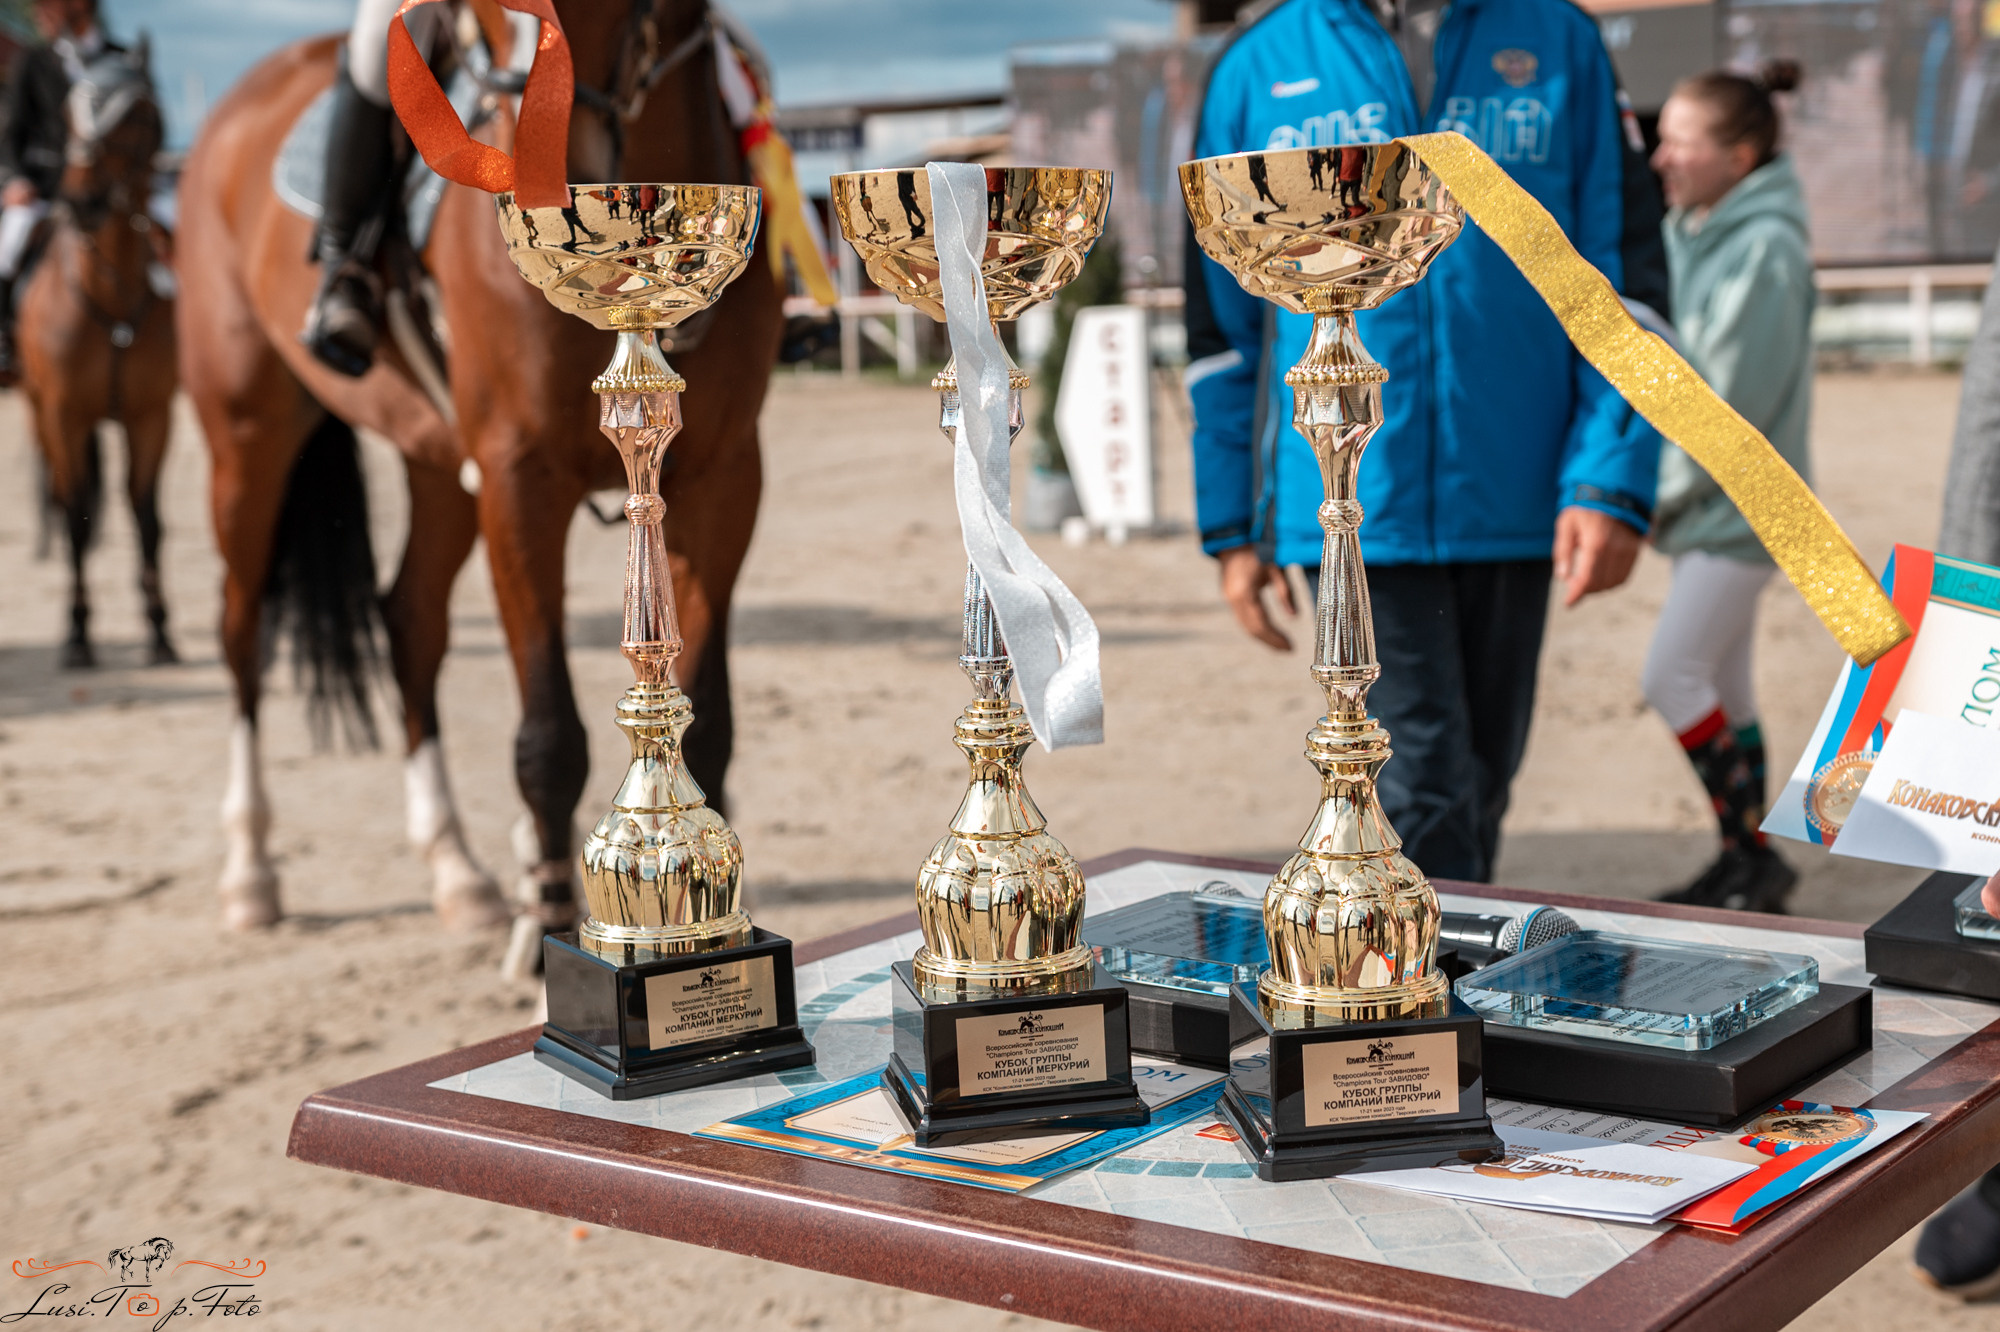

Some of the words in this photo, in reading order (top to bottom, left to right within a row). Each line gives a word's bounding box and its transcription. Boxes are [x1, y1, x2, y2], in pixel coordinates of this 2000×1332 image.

[680, 1011, 709, 1022] КУБОК
[712, 1004, 746, 1017] ГРУППЫ
[665, 1018, 714, 1034] КОМПАНИЙ
[717, 1009, 762, 1024] МЕРКУРИЙ
[986, 1042, 1033, 1052] Всероссийские
[1035, 1038, 1078, 1048] соревнования
[1039, 1044, 1078, 1053] ЗАВИДОВО"
[995, 1058, 1028, 1069] КУБОК
[1030, 1054, 1071, 1066] ГРУППЫ
[978, 1066, 1033, 1080] КОМПАНИЙ
[1037, 1060, 1089, 1073] МЕРКУРИЙ
[1333, 1071, 1382, 1080] Всероссийские
[1384, 1067, 1429, 1077] соревнования
[1334, 1079, 1371, 1088] "Champions
[1389, 1074, 1429, 1082] ЗАВИДОВО"
[1342, 1087, 1376, 1098] КУБОК
[1380, 1084, 1421, 1095] ГРУППЫ
[1324, 1096, 1382, 1110] КОМПАНИЙ
[1386, 1090, 1441, 1104] МЕРКУРИЙ
